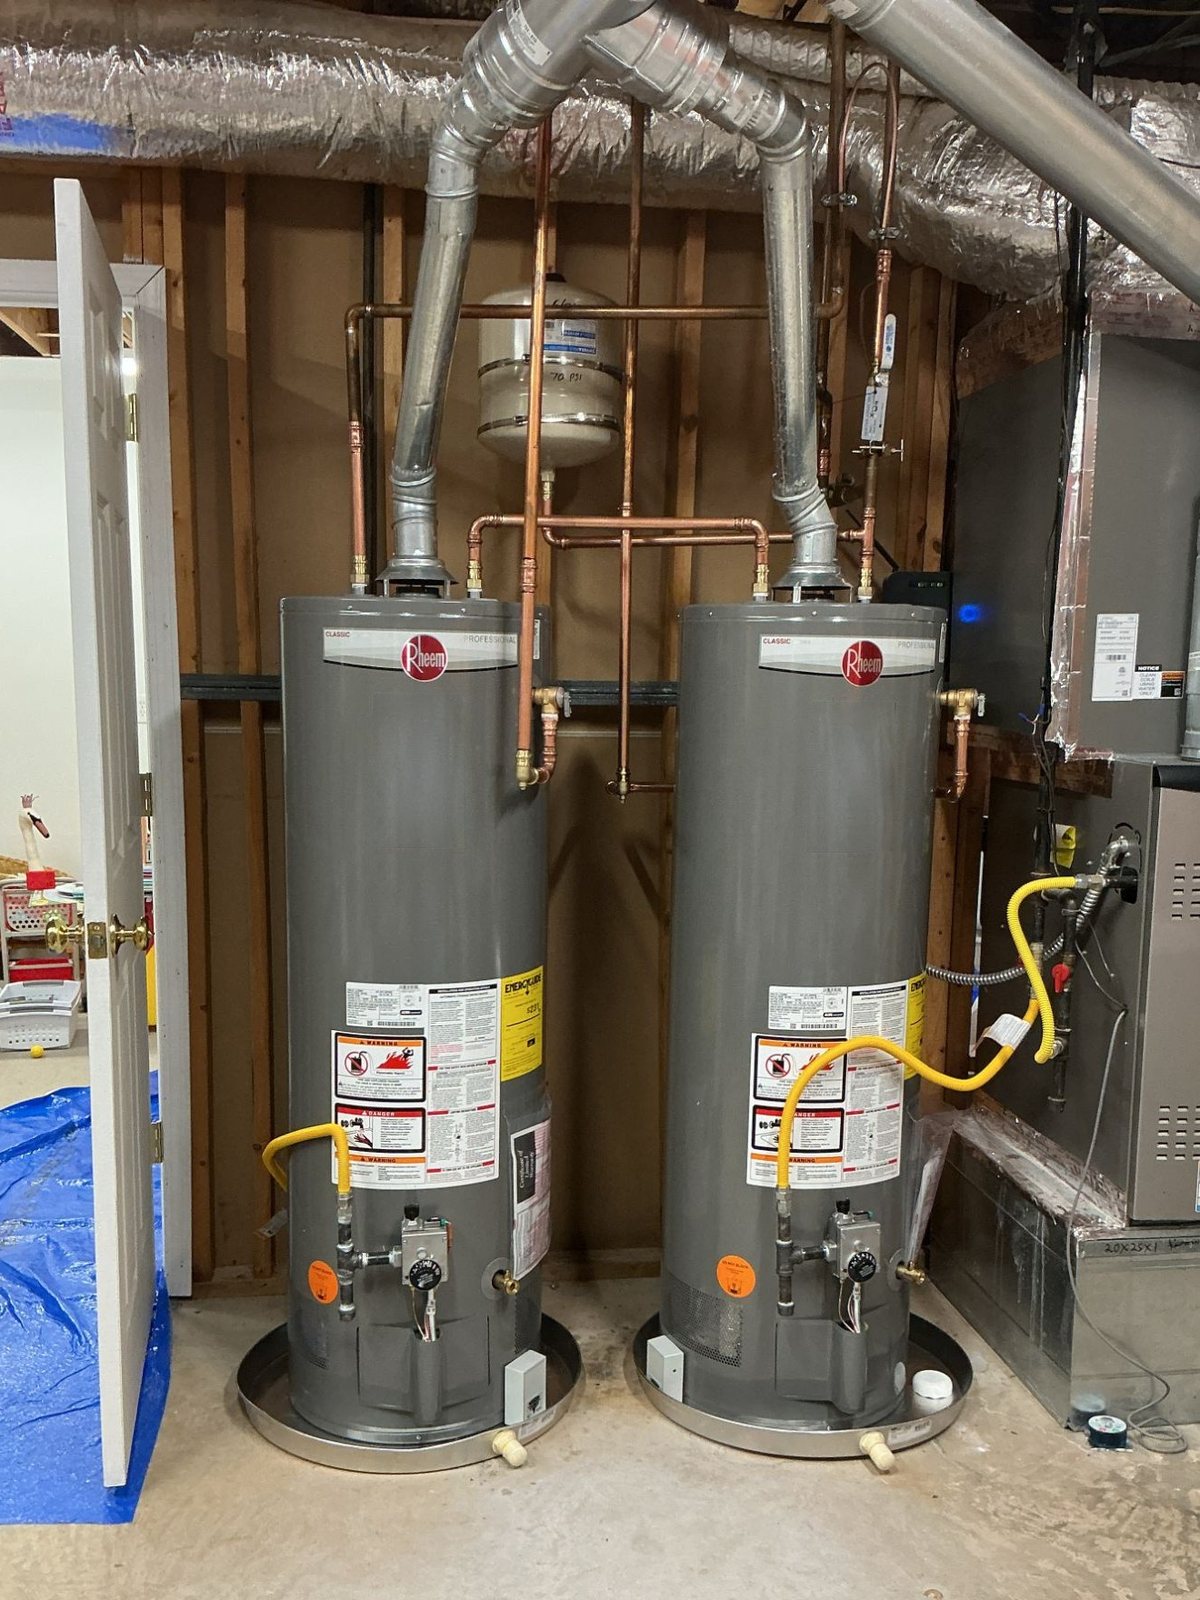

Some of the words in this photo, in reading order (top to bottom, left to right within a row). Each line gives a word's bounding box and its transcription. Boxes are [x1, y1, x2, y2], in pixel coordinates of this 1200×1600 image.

[551, 371, 565, 382] 70
[406, 635, 445, 674] Rheem
[846, 641, 881, 679] Rheem
